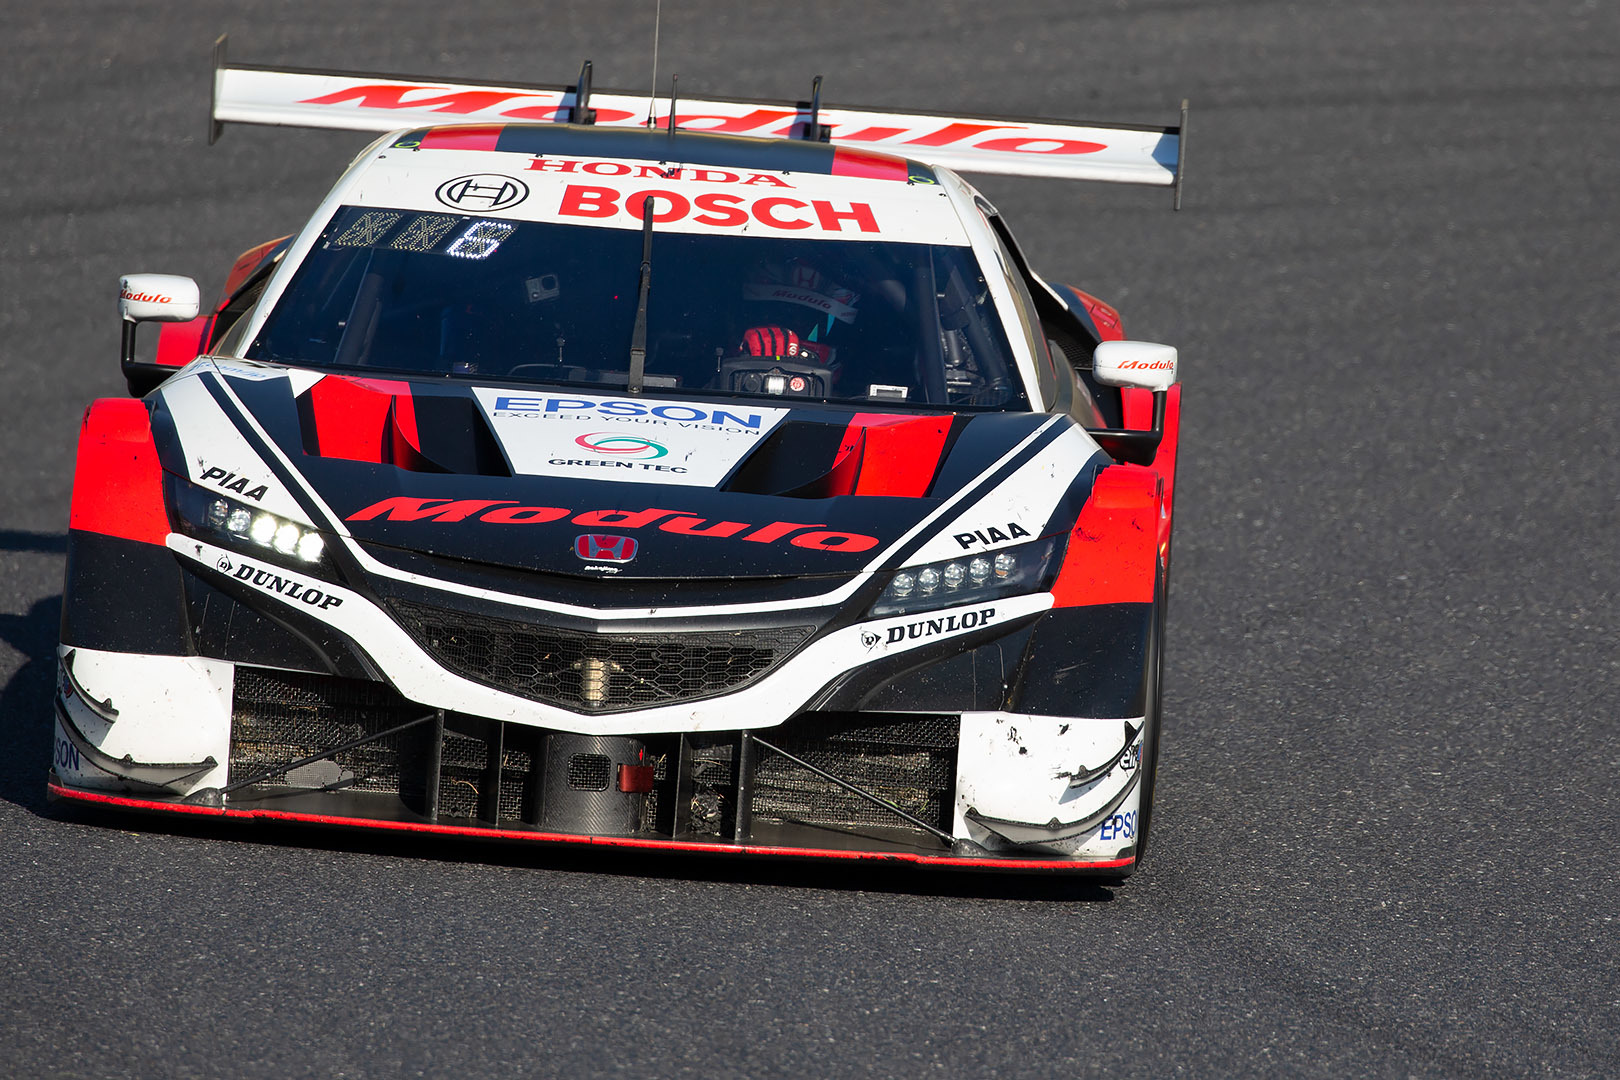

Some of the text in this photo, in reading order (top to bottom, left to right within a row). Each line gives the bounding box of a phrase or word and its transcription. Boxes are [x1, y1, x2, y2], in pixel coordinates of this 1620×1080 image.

[297, 84, 1108, 155] Modulo
[524, 158, 797, 189] HONDA
[558, 184, 881, 233] BOSCH
[120, 288, 173, 304] Modulo
[1117, 359, 1174, 370] Modulo
[493, 411, 760, 436] EXCEED YOUR VISION
[494, 396, 762, 429] EPSON
[548, 458, 689, 474] GREEN TEC
[200, 466, 269, 502] PIAA
[345, 496, 881, 554] Modulo
[953, 521, 1031, 550] PIAA
[233, 563, 344, 610] DUNLOP
[885, 607, 996, 645] DUNLOP
